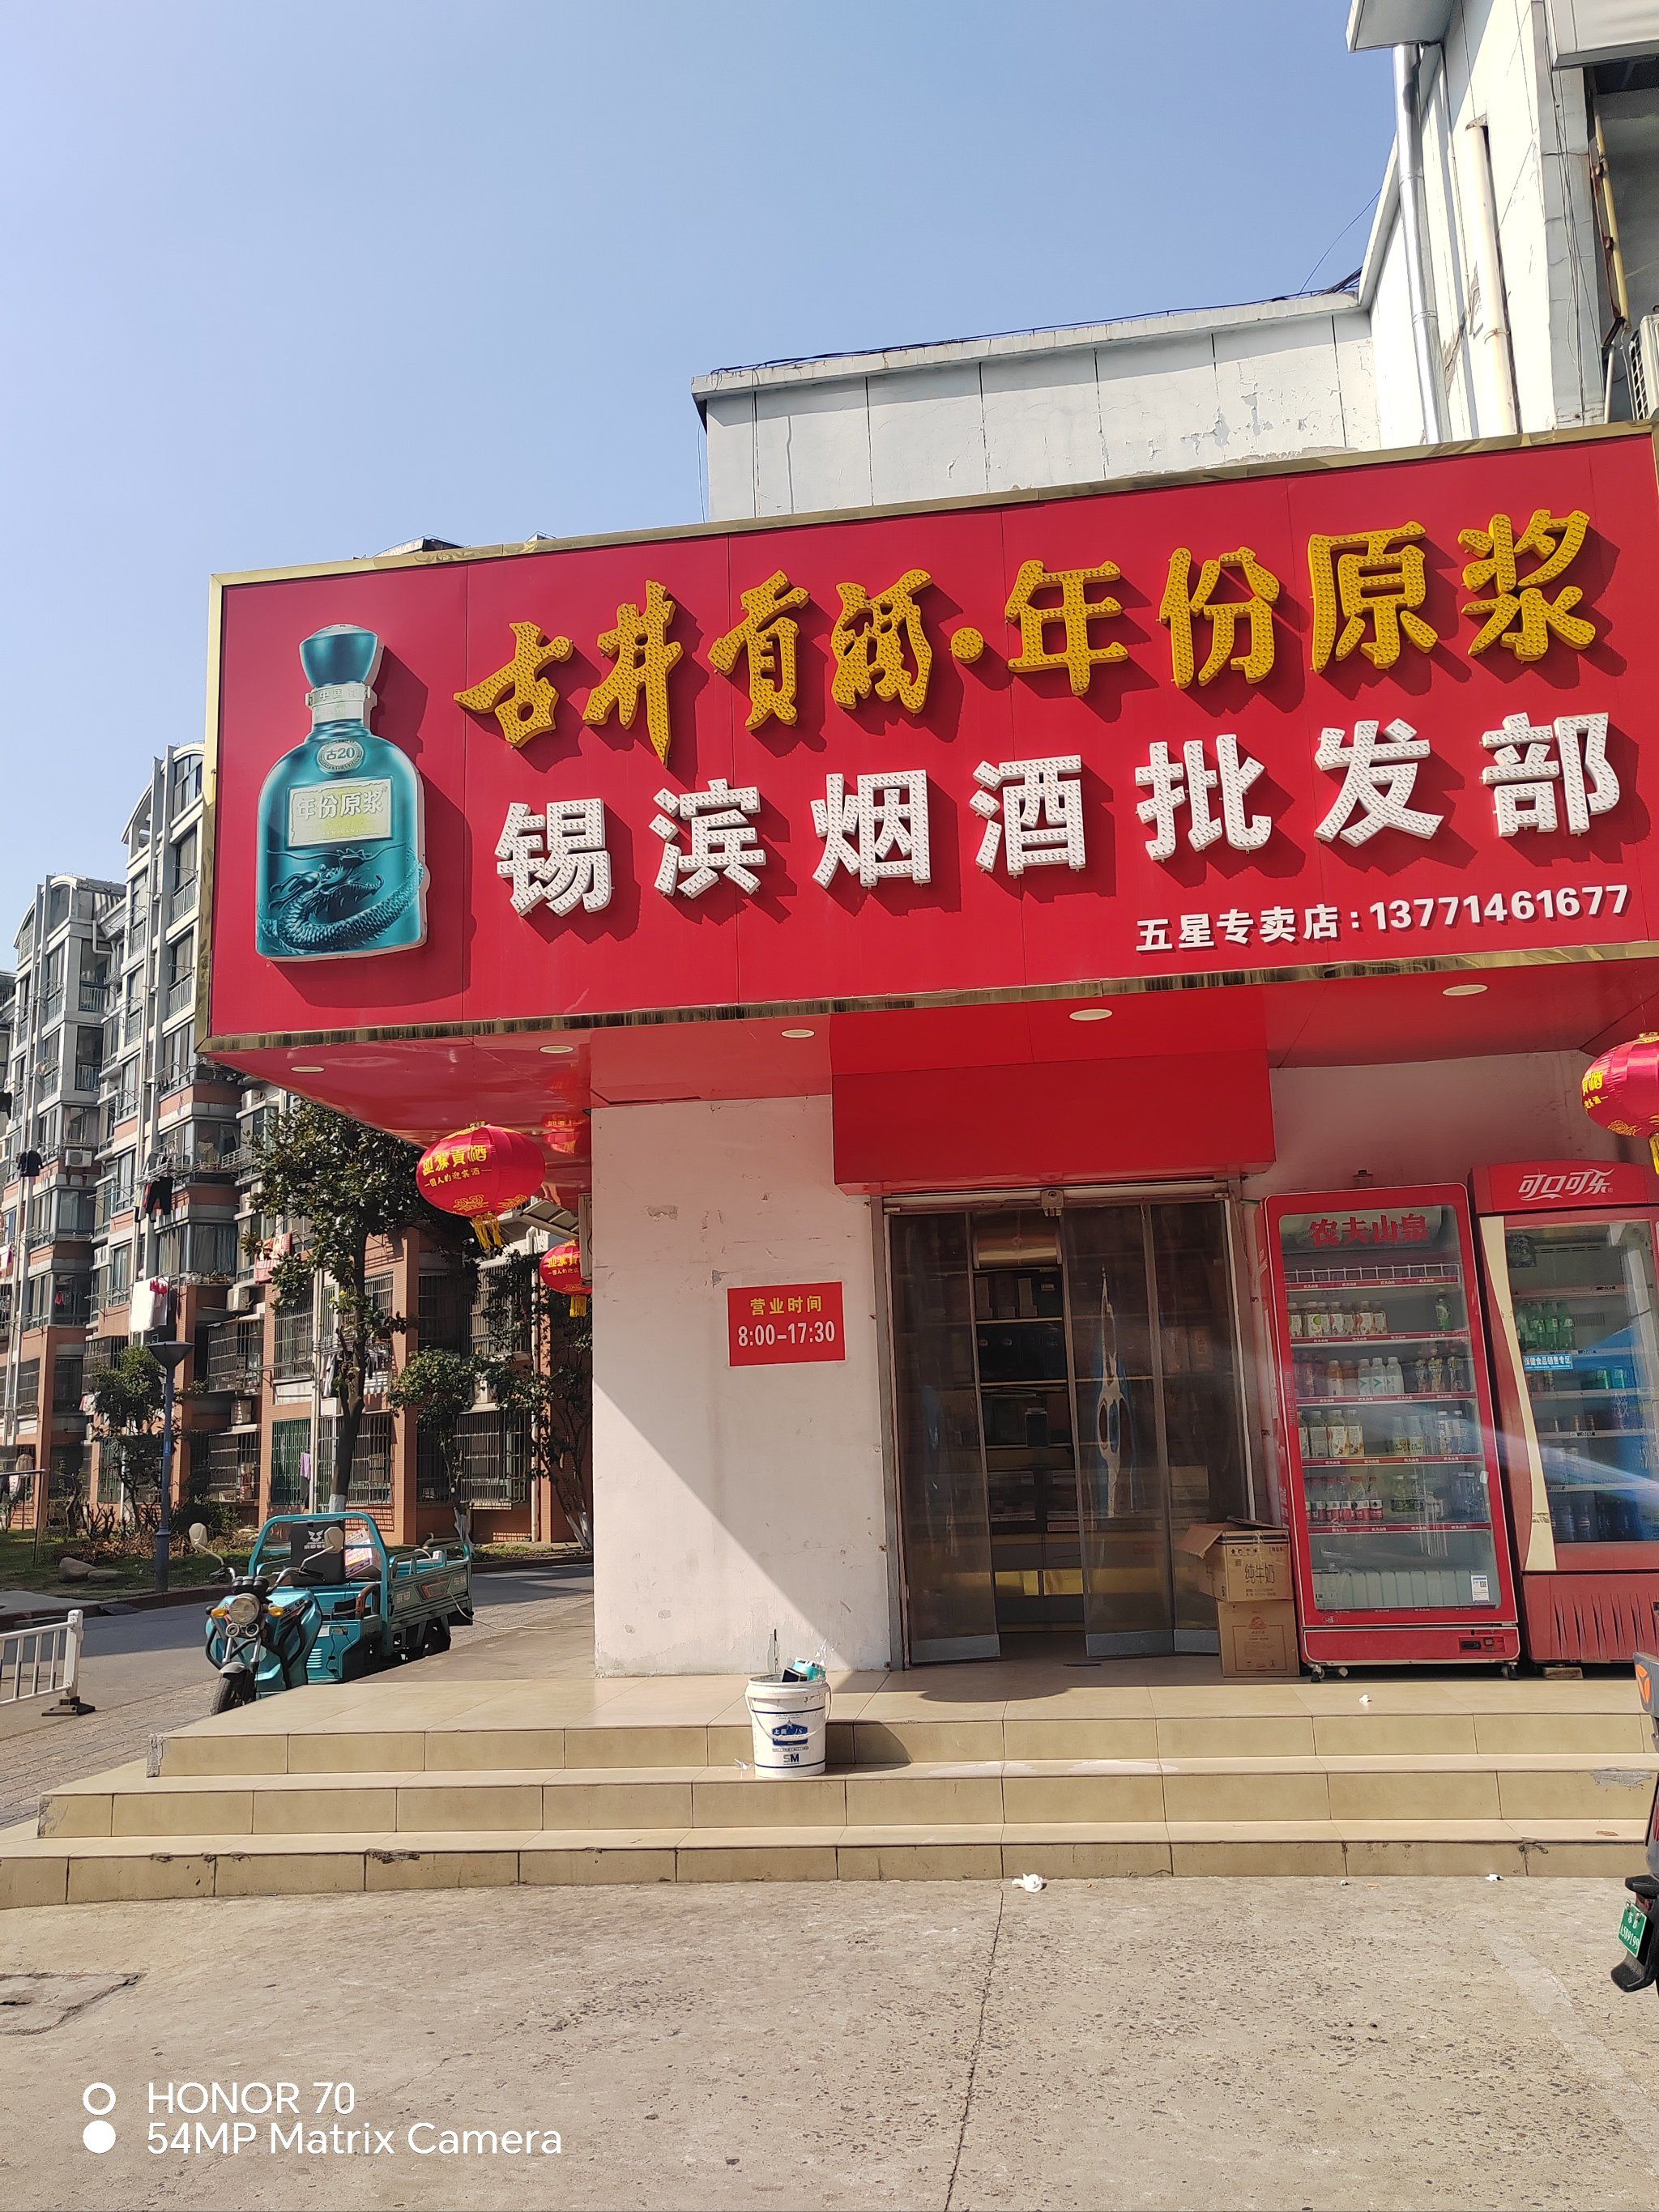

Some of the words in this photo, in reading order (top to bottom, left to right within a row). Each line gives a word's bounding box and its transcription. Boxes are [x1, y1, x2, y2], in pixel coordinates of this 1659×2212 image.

[326, 747, 356, 761] 古20
[295, 791, 383, 820] 年份原浆
[494, 713, 1621, 917] 锡滨烟酒批发部
[1518, 1168, 1615, 1200] 可口可乐
[1309, 1213, 1429, 1247] 农夫山泉
[749, 1295, 821, 1316] 营业时间
[738, 1320, 835, 1347] 8:00-17:30
[1244, 1562, 1276, 1584] 纯牛奶
